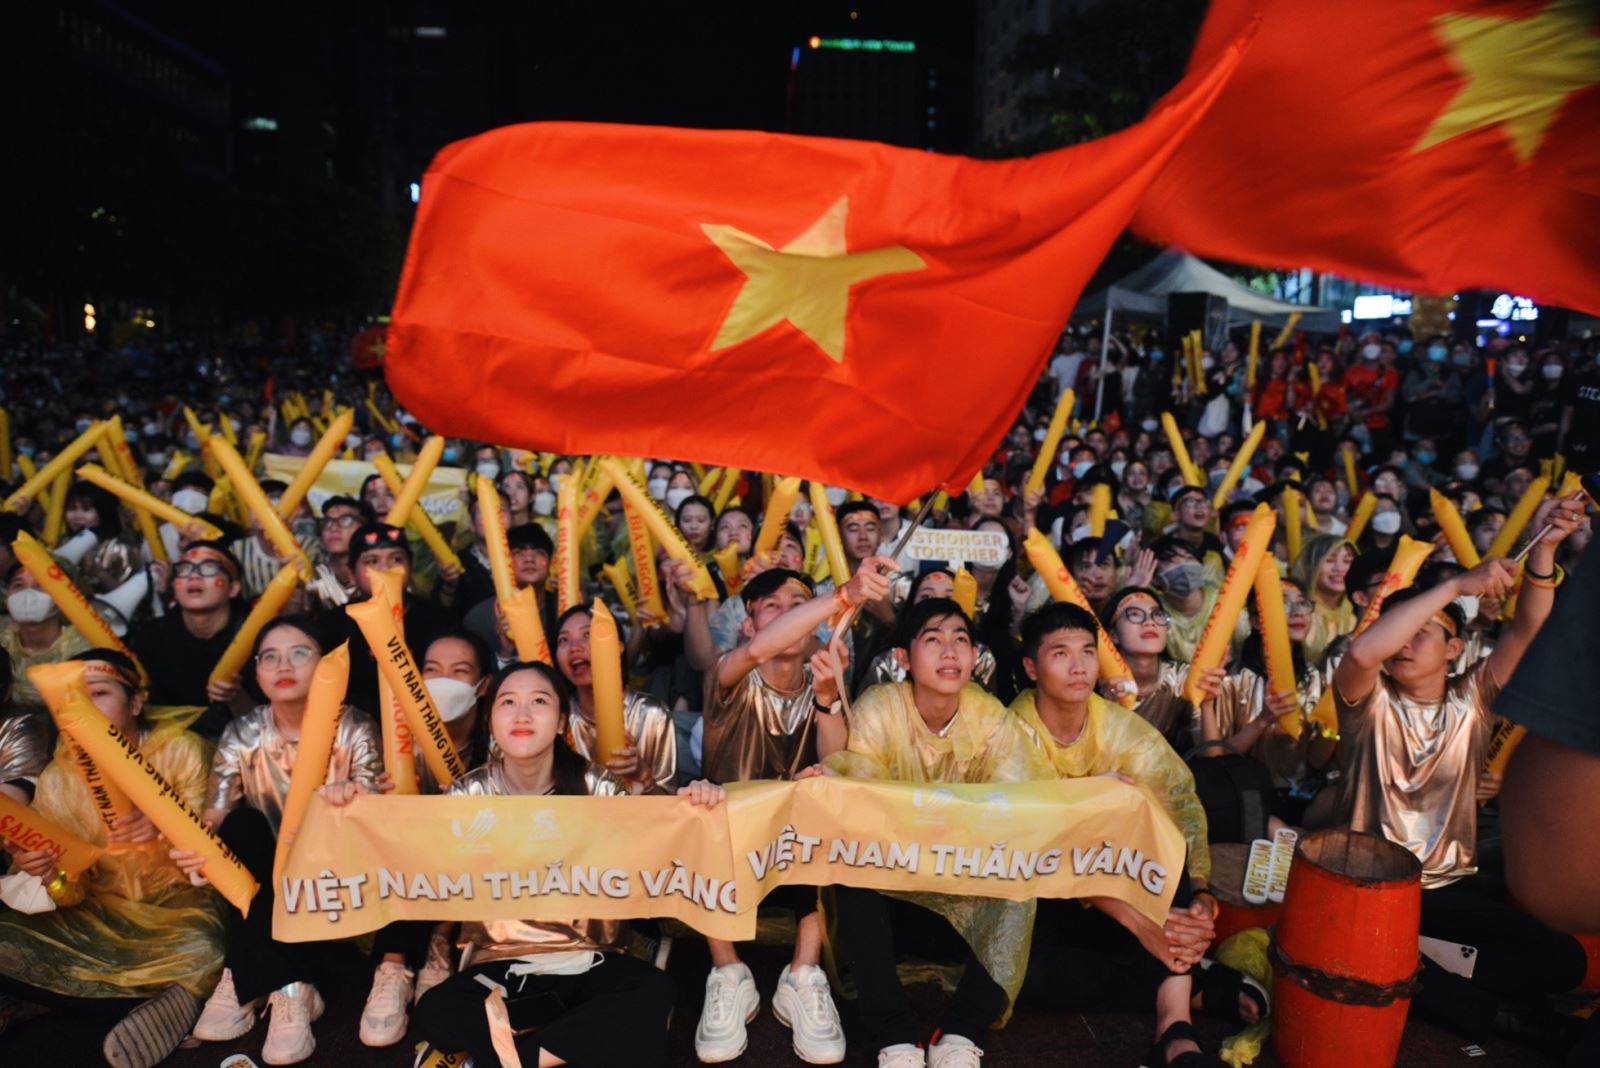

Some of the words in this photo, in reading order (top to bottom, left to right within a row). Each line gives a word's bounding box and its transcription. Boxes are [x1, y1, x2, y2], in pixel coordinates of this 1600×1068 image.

[629, 515, 641, 541] BIA
[634, 543, 654, 597] SAIGON
[911, 544, 999, 561] TOGETHER
[387, 635, 409, 669] VIỆT
[403, 670, 425, 704] NAM
[107, 724, 144, 766] VÀNG
[92, 785, 113, 810] NAM
[746, 824, 822, 881] VIỆT
[828, 838, 921, 873] NAM
[931, 840, 1063, 882] THẮNG
[1071, 840, 1168, 896] VÀNG
[282, 868, 369, 923] VIỆT
[377, 867, 474, 901] NAM
[483, 858, 631, 900] THẮNG
